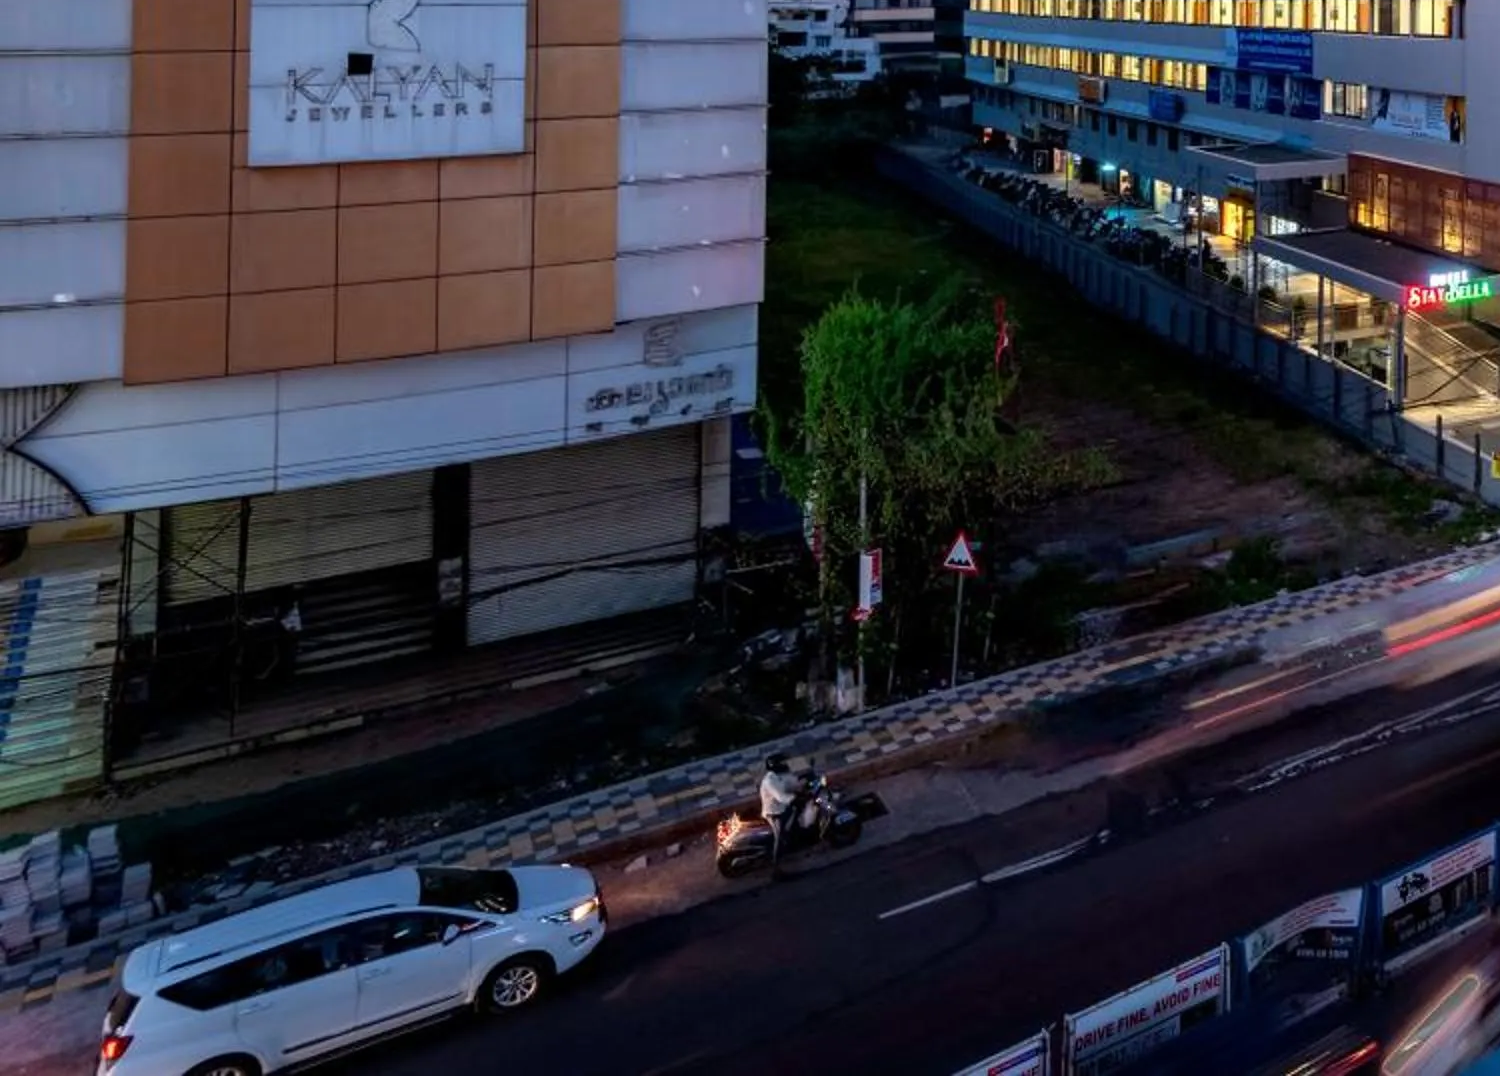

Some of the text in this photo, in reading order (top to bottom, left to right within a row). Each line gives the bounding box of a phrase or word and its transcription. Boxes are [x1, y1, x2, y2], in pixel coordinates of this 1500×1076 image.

[287, 60, 495, 105] KALYAN
[285, 100, 493, 123] JEWELLERS
[1075, 1023, 1115, 1052] DRIVE
[1153, 987, 1190, 1016] AVOID
[1193, 972, 1221, 996] FINE
